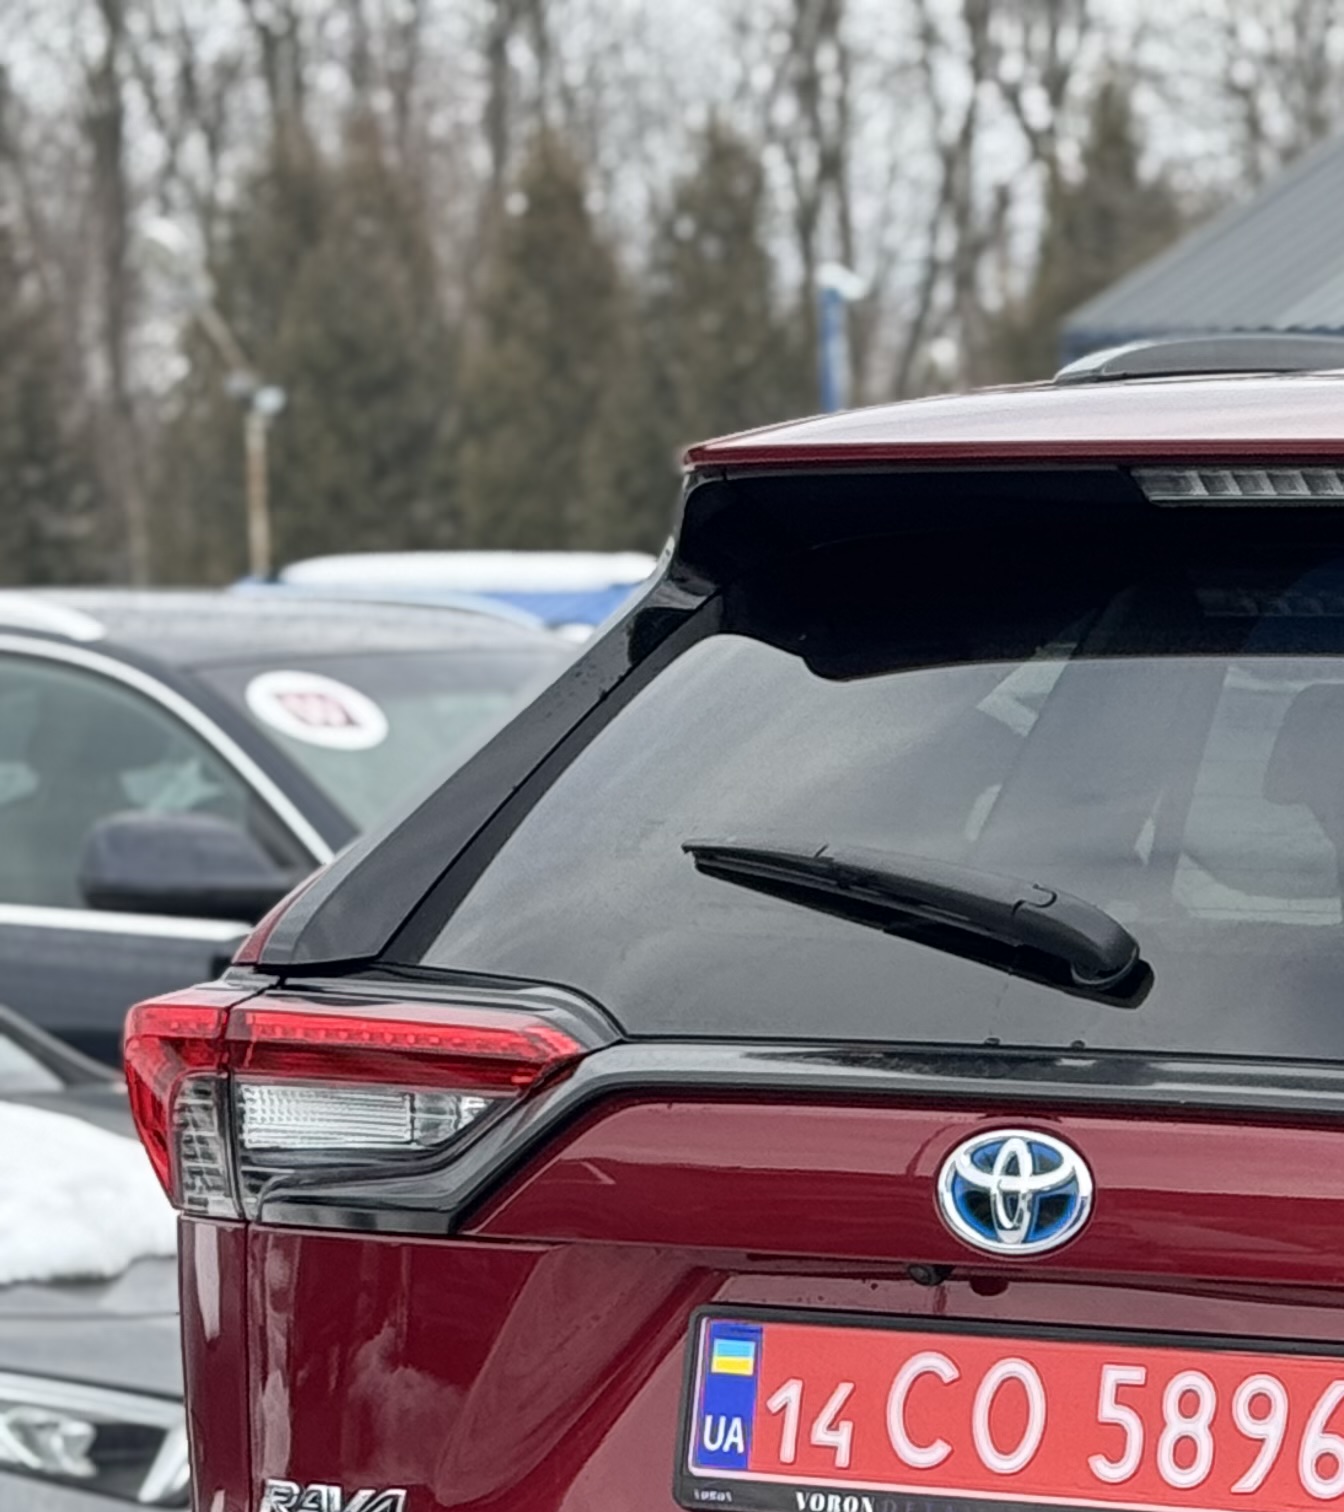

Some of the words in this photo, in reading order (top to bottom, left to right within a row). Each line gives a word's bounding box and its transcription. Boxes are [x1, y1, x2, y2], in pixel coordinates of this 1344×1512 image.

[703, 1414, 745, 1454] UA
[766, 1378, 854, 1468] 14
[886, 1351, 1047, 1474] CO
